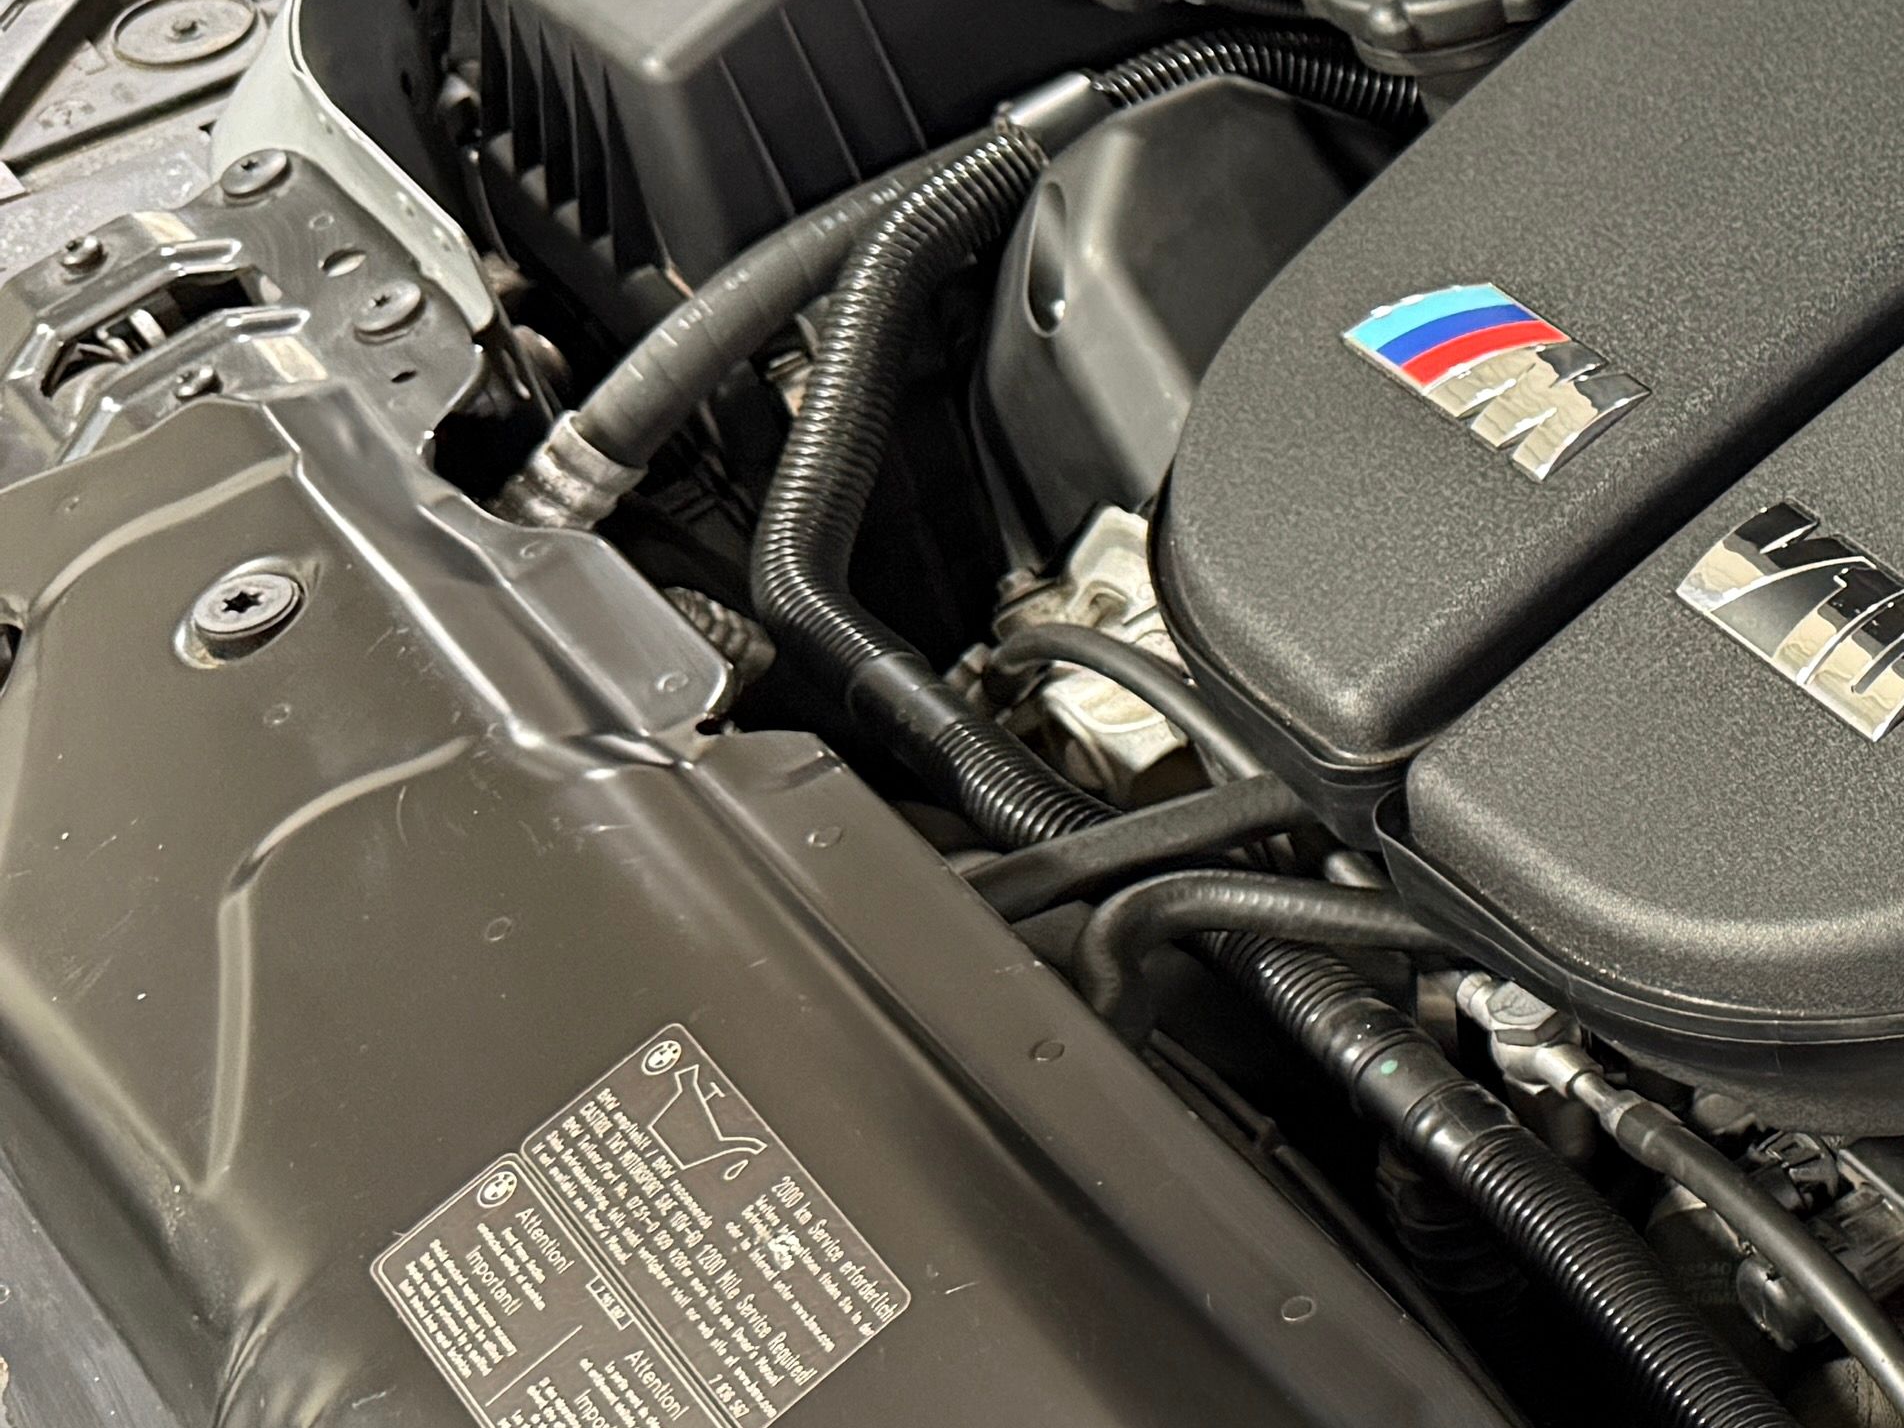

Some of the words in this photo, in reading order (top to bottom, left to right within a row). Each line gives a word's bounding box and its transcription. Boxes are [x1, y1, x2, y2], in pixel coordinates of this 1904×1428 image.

[515, 1208, 575, 1274] Attention!
[771, 1176, 804, 1208] 2000
[793, 1201, 812, 1225] km
[807, 1219, 844, 1262] Service
[839, 1261, 898, 1322] erforderlich
[465, 1245, 523, 1316] Important!
[695, 1244, 726, 1275] 1200
[715, 1269, 742, 1299] Mile
[736, 1293, 772, 1338] Service
[767, 1331, 818, 1386] Required!
[624, 1350, 689, 1421] Attention!
